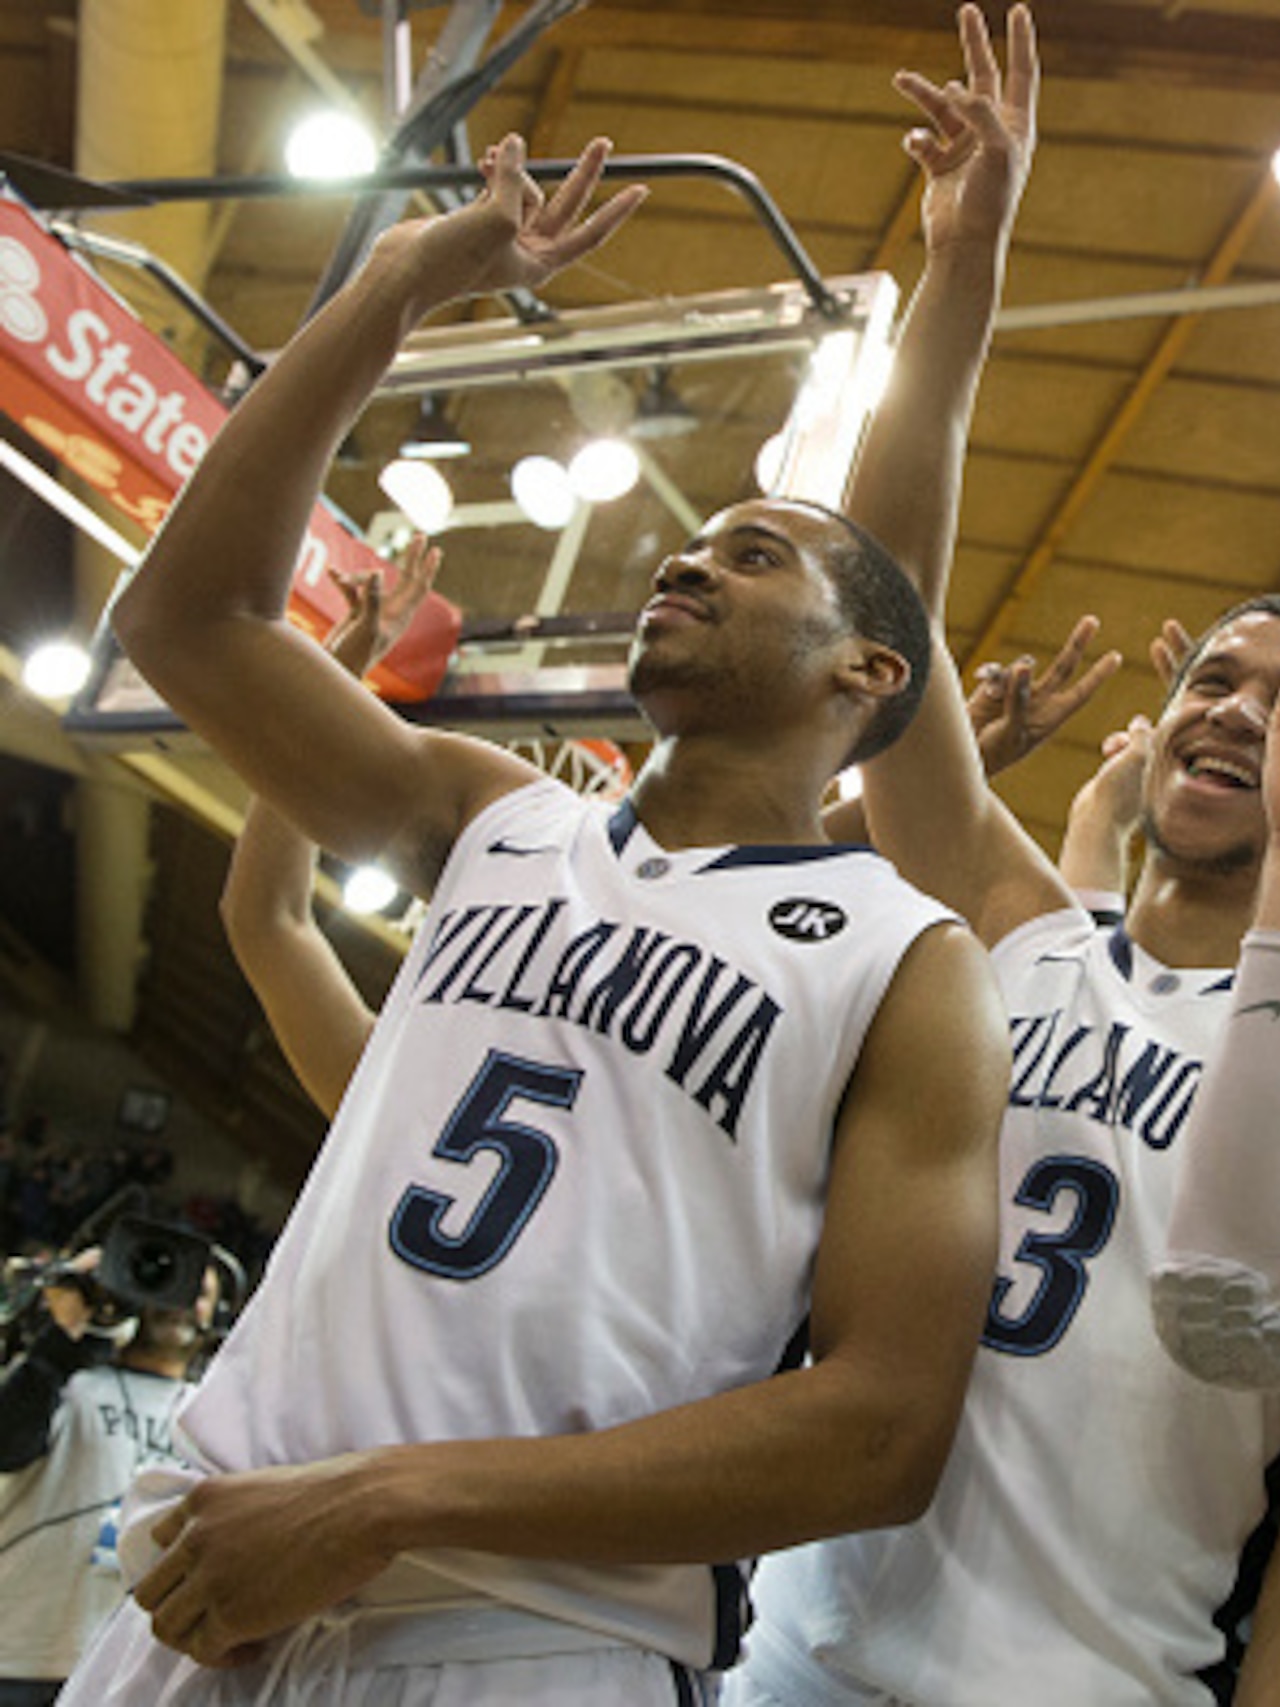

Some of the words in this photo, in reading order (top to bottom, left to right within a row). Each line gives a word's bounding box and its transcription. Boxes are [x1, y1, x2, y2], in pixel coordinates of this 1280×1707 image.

[46, 309, 208, 476] State
[773, 902, 841, 937] JK
[413, 897, 784, 1144] VILLANOVA
[1009, 1008, 1204, 1150] ILLANO
[388, 1046, 586, 1281] 5
[979, 1154, 1120, 1357] 3
